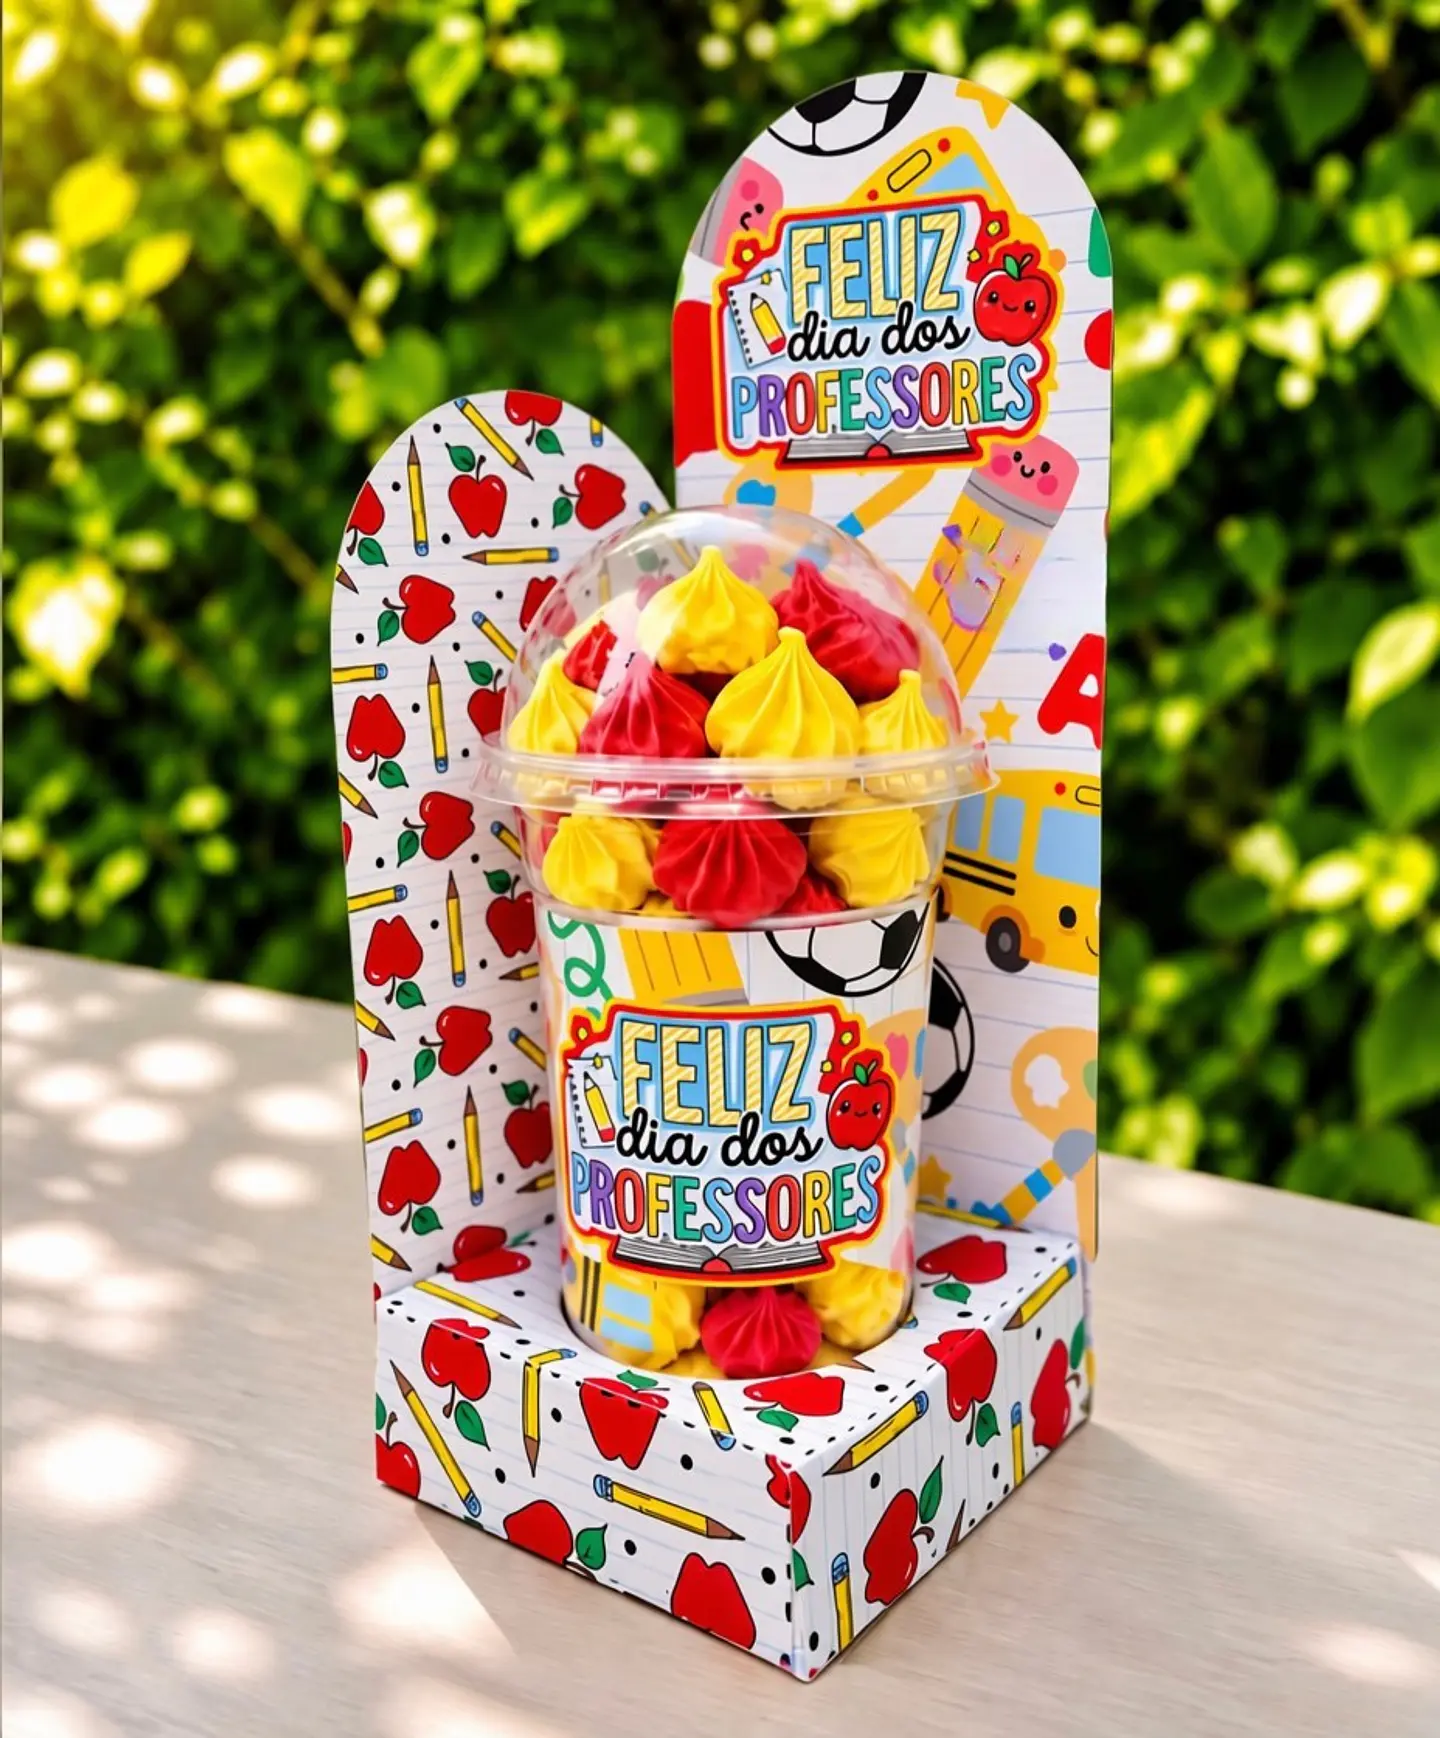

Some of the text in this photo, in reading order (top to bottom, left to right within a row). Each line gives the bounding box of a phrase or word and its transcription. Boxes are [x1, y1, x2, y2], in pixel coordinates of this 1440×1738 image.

[789, 209, 962, 324] FELIZ
[787, 300, 971, 362] dia dos
[731, 353, 1037, 439] PROFESSORES
[620, 1020, 812, 1127] FELIZ
[616, 1107, 823, 1166] dia dos
[572, 1152, 881, 1244] PROFESSORES
